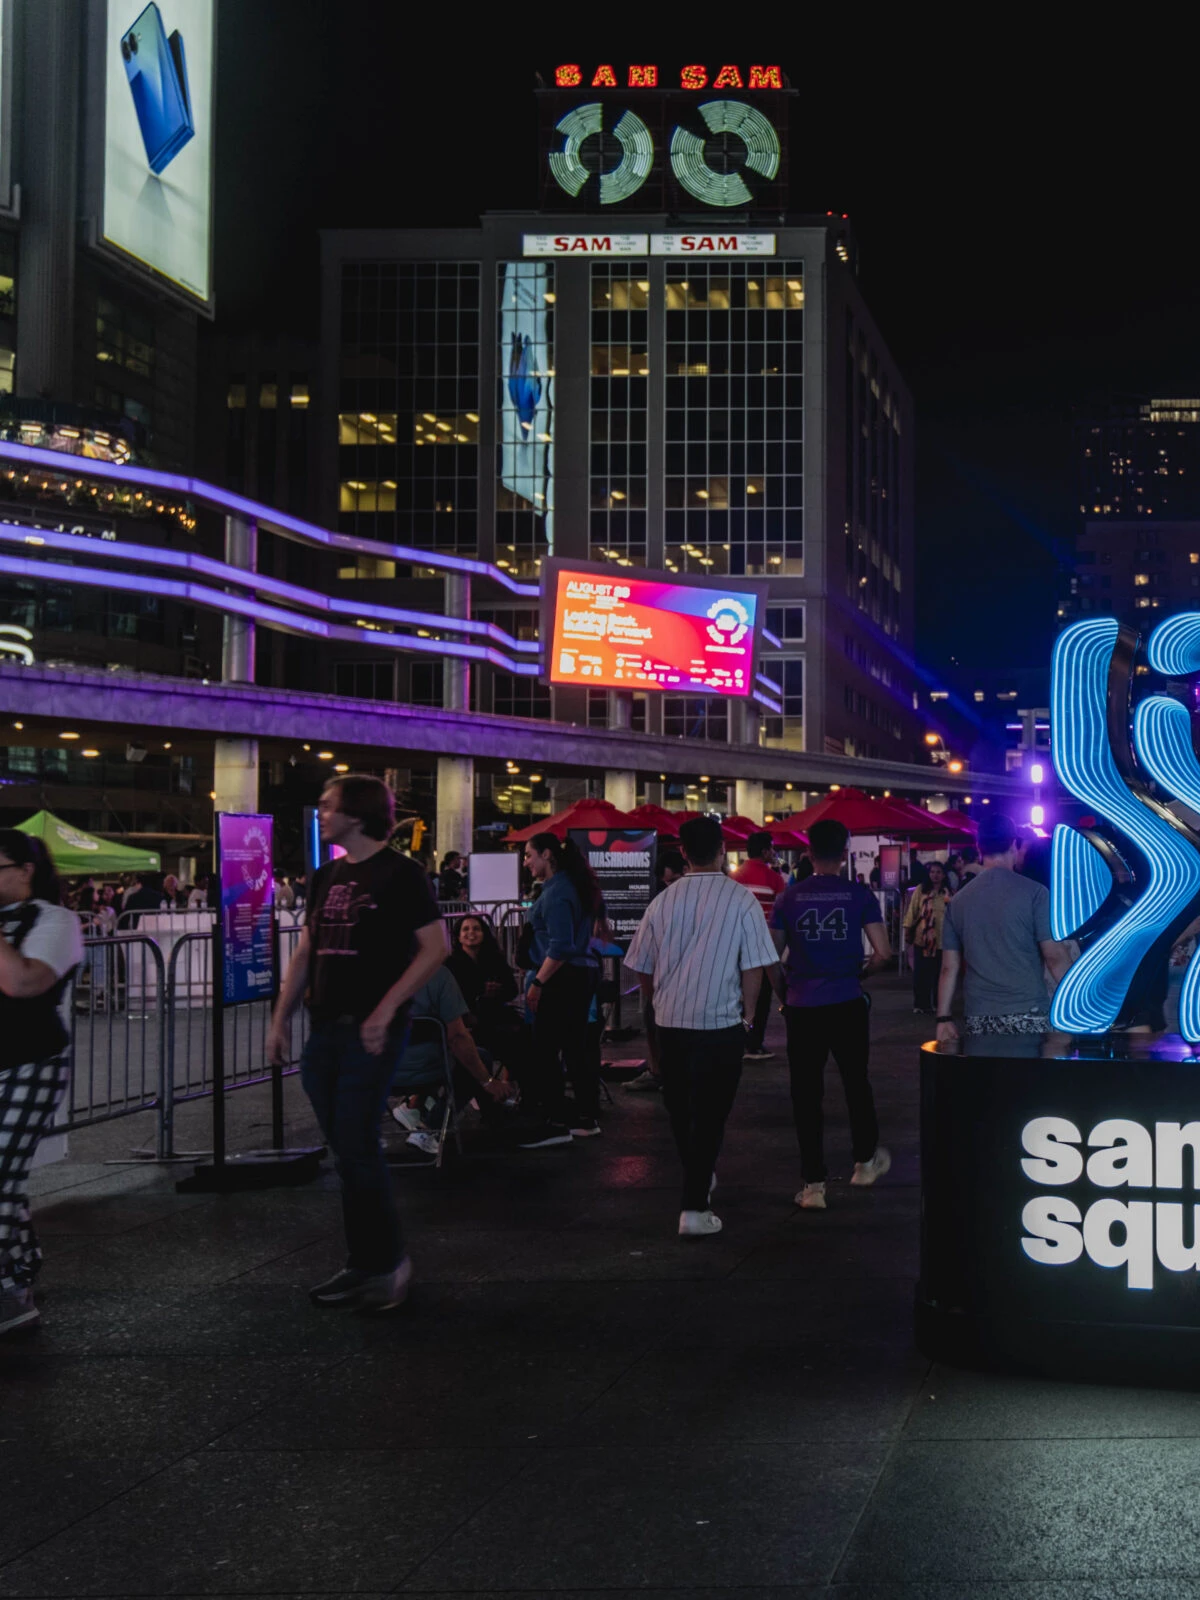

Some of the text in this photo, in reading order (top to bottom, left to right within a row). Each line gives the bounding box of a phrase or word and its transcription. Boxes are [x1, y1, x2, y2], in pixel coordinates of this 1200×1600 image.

[555, 64, 658, 87] SAM
[681, 65, 783, 90] SAM
[553, 237, 612, 252] SAM
[680, 236, 739, 251] SAM
[566, 581, 613, 597] AUGUST
[588, 851, 650, 868] WASHROOMS
[617, 918, 641, 926] sanko
[796, 907, 849, 941] 44
